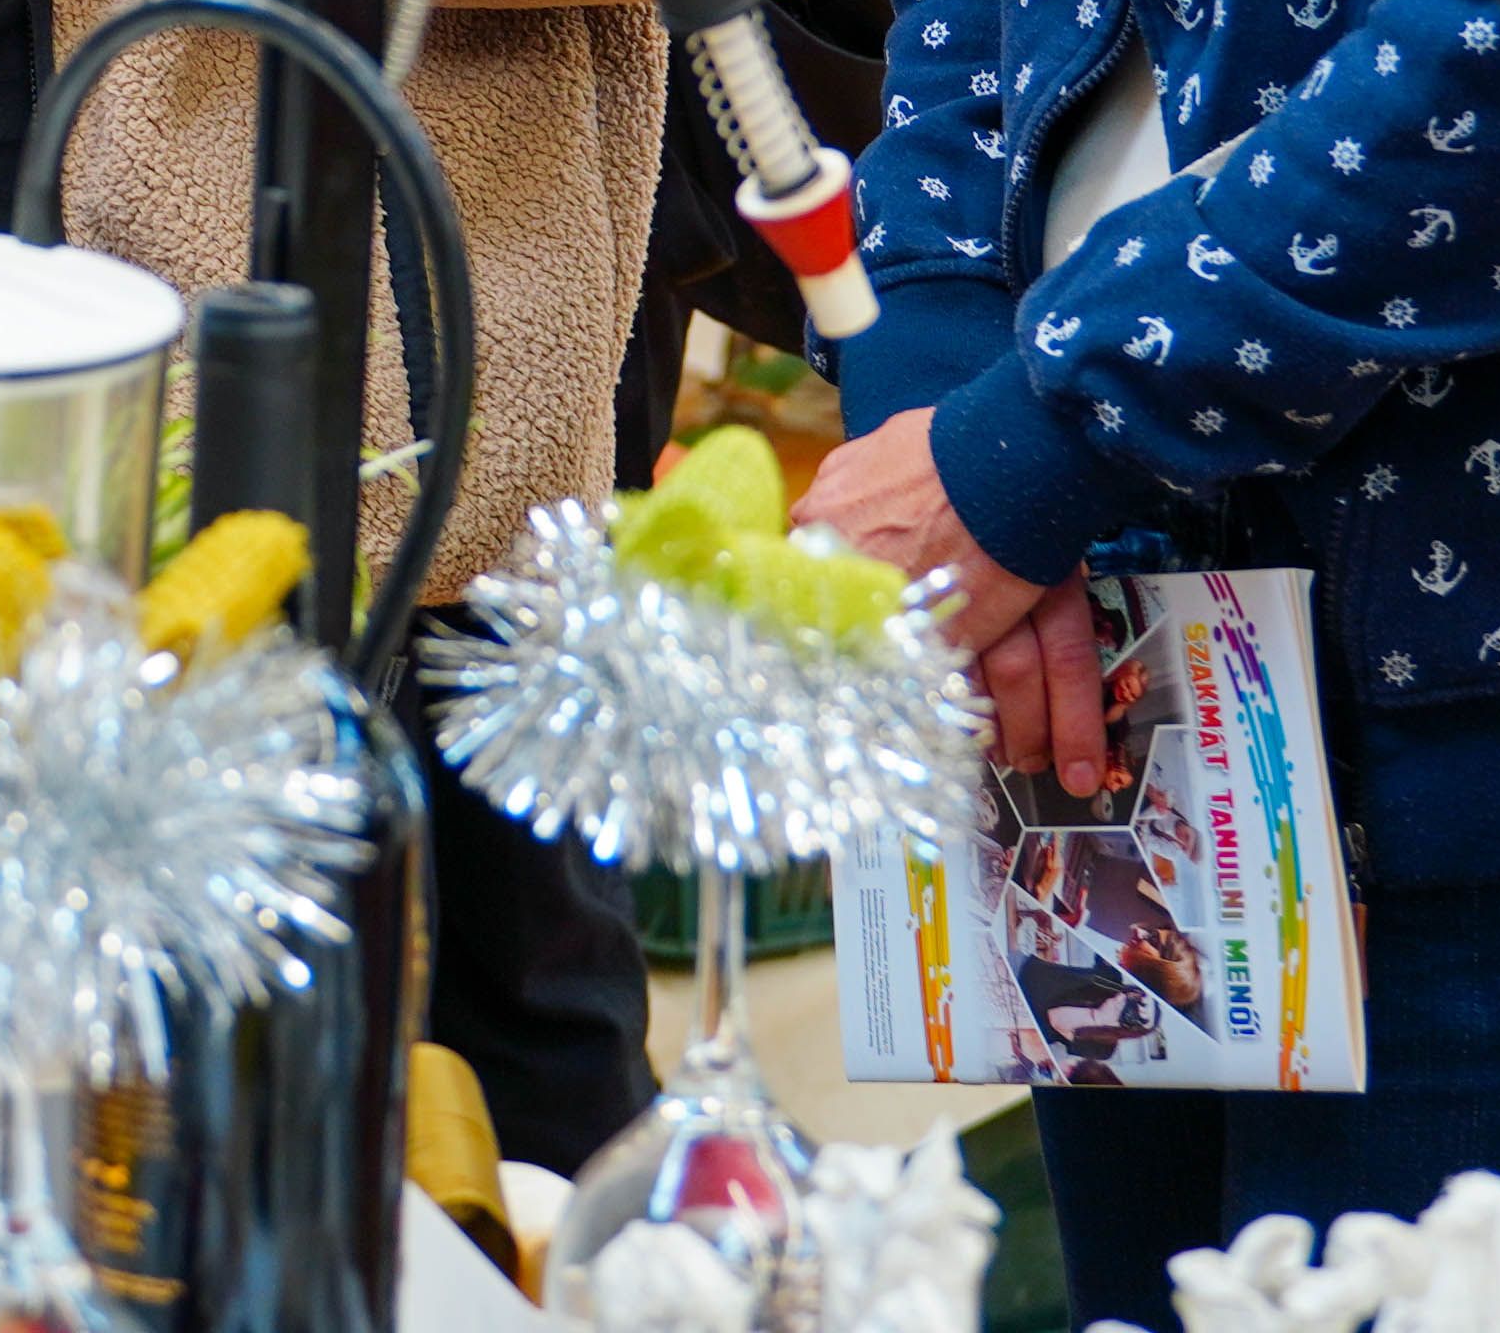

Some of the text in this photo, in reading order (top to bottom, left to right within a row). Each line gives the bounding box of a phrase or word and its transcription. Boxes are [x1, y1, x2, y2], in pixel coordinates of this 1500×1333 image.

[1182, 622, 1262, 1042] SZAKMÁT TANULNI MENŐ!
